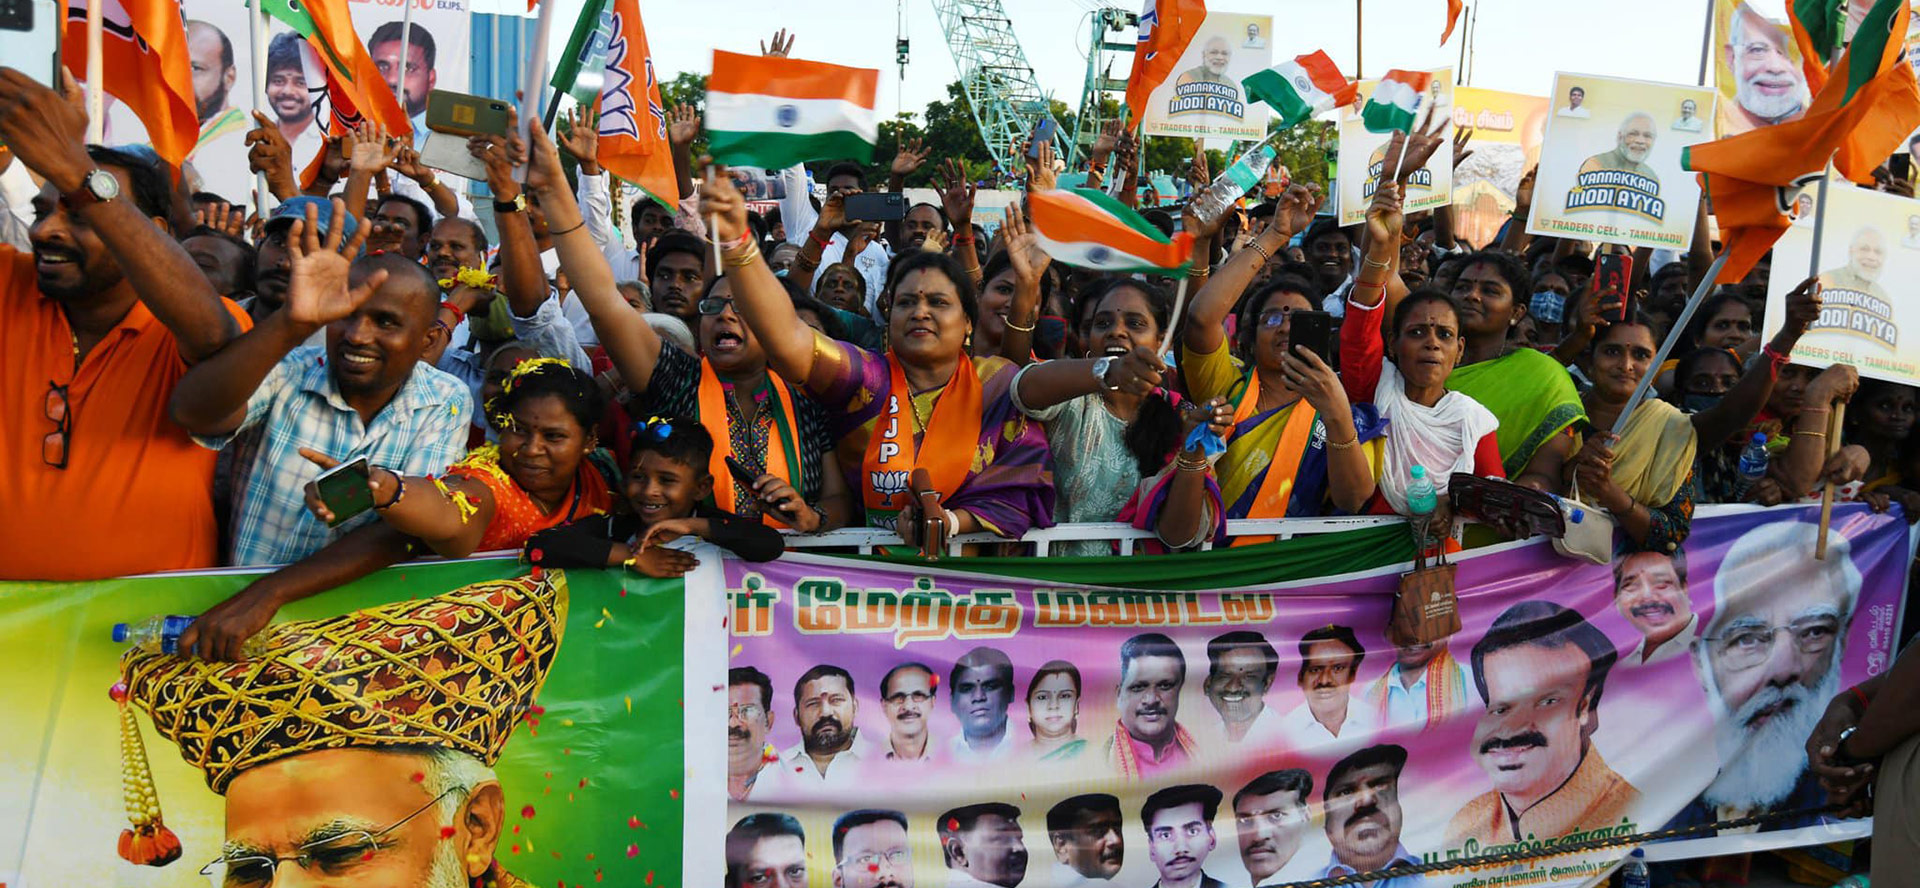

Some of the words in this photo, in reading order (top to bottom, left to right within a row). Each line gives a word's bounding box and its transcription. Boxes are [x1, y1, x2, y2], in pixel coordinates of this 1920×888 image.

[1177, 82, 1237, 99] VANNAKKAM
[1170, 96, 1204, 113] MODI
[1206, 96, 1243, 118] AYYA
[1160, 123, 1193, 133] TRADERS
[1194, 124, 1211, 134] CELL
[1219, 126, 1260, 136] TAMILNADU
[1579, 171, 1659, 195] VANNAKKAM
[1410, 193, 1446, 208] TAMILNADU
[1568, 188, 1615, 207] MODI
[1616, 190, 1664, 218] AYYA
[1552, 220, 1594, 234] TRADERS
[1596, 225, 1619, 237] CELL
[1629, 229, 1683, 244] TAMILNADU
[1821, 290, 1891, 318] ANNAKKAM
[1815, 308, 1848, 328] ODI
[1851, 311, 1896, 345] AYYA
[1792, 344, 1830, 360] RADERS
[1832, 350, 1855, 364] CELL
